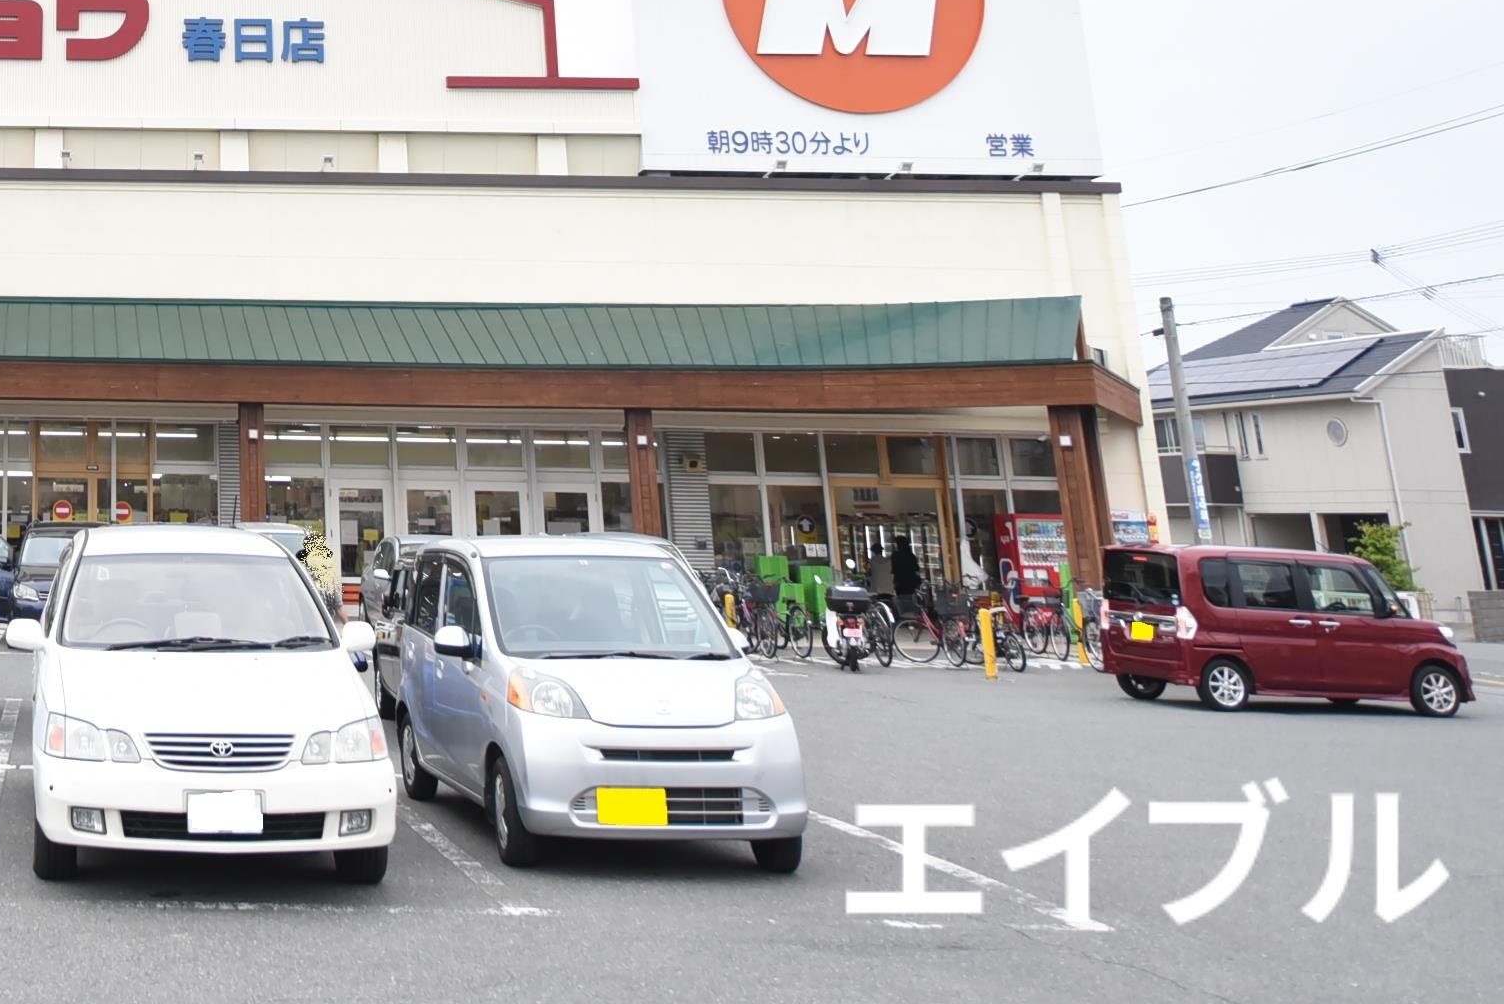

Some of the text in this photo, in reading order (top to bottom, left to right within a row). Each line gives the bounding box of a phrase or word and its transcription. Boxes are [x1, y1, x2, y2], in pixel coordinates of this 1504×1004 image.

[180, 16, 326, 64] 春日店
[706, 129, 1036, 159] 朝9時30分より 営業
